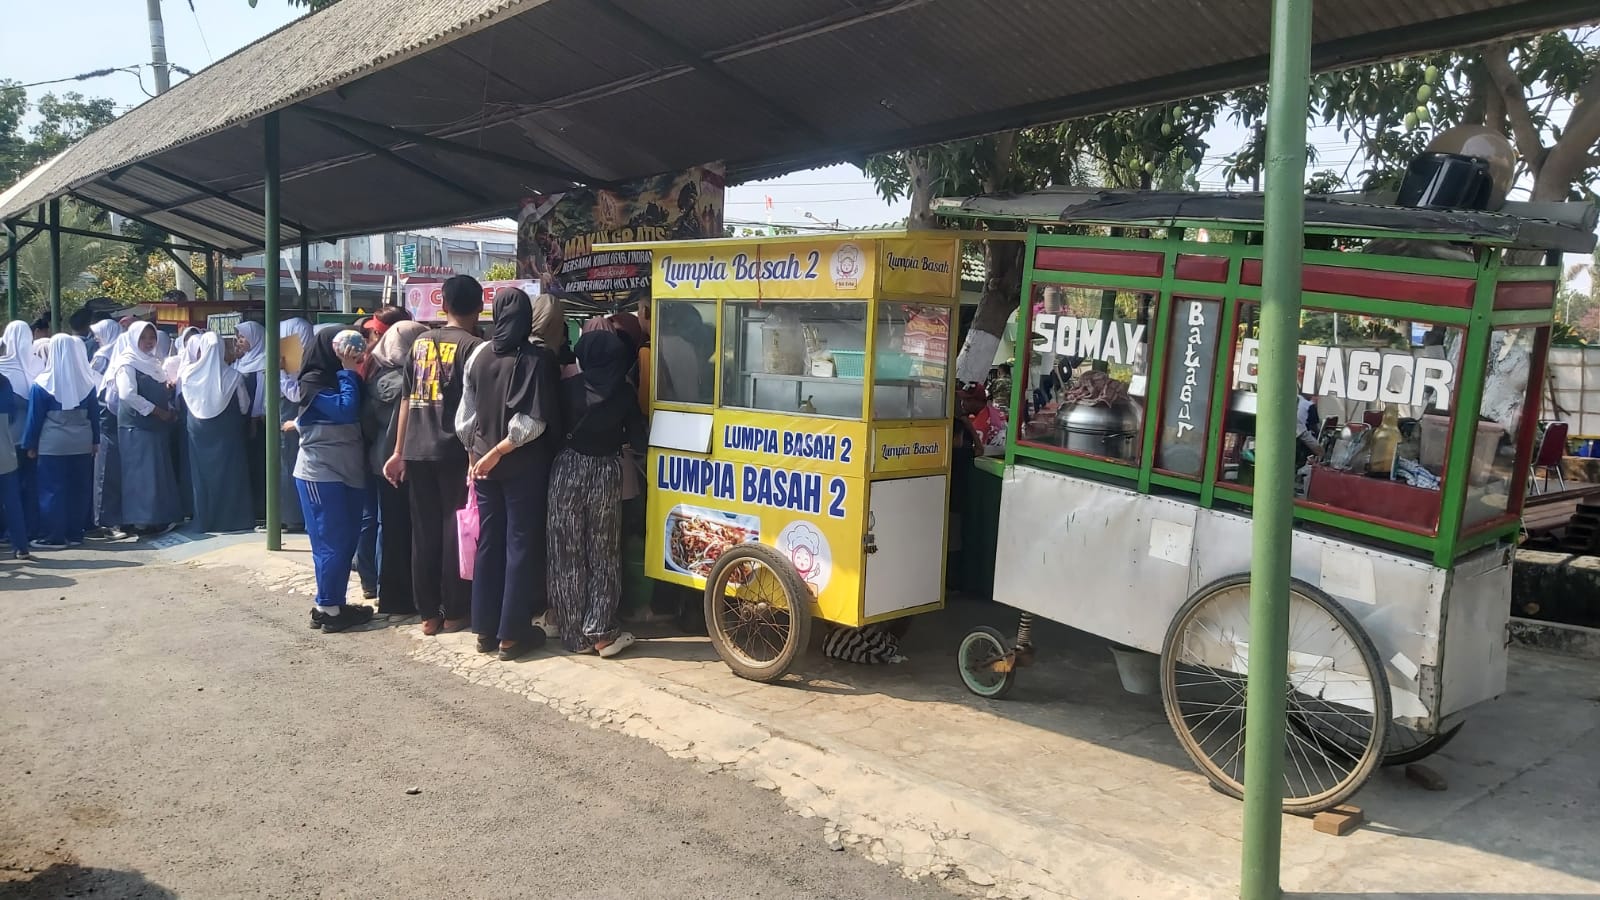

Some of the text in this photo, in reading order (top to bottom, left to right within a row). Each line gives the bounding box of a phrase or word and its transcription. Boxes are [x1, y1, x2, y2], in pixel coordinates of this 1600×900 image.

[661, 254, 727, 288] Lumpia
[732, 252, 801, 281] Basah
[805, 250, 820, 279] 2
[886, 251, 950, 273] Lumpia Basah
[1032, 313, 1146, 365] SOMAY
[724, 425, 851, 463] LUMPIA BASAH 2
[881, 443, 939, 460] Lumpia Basah
[657, 455, 846, 518] LUMPIA BASAH 2
